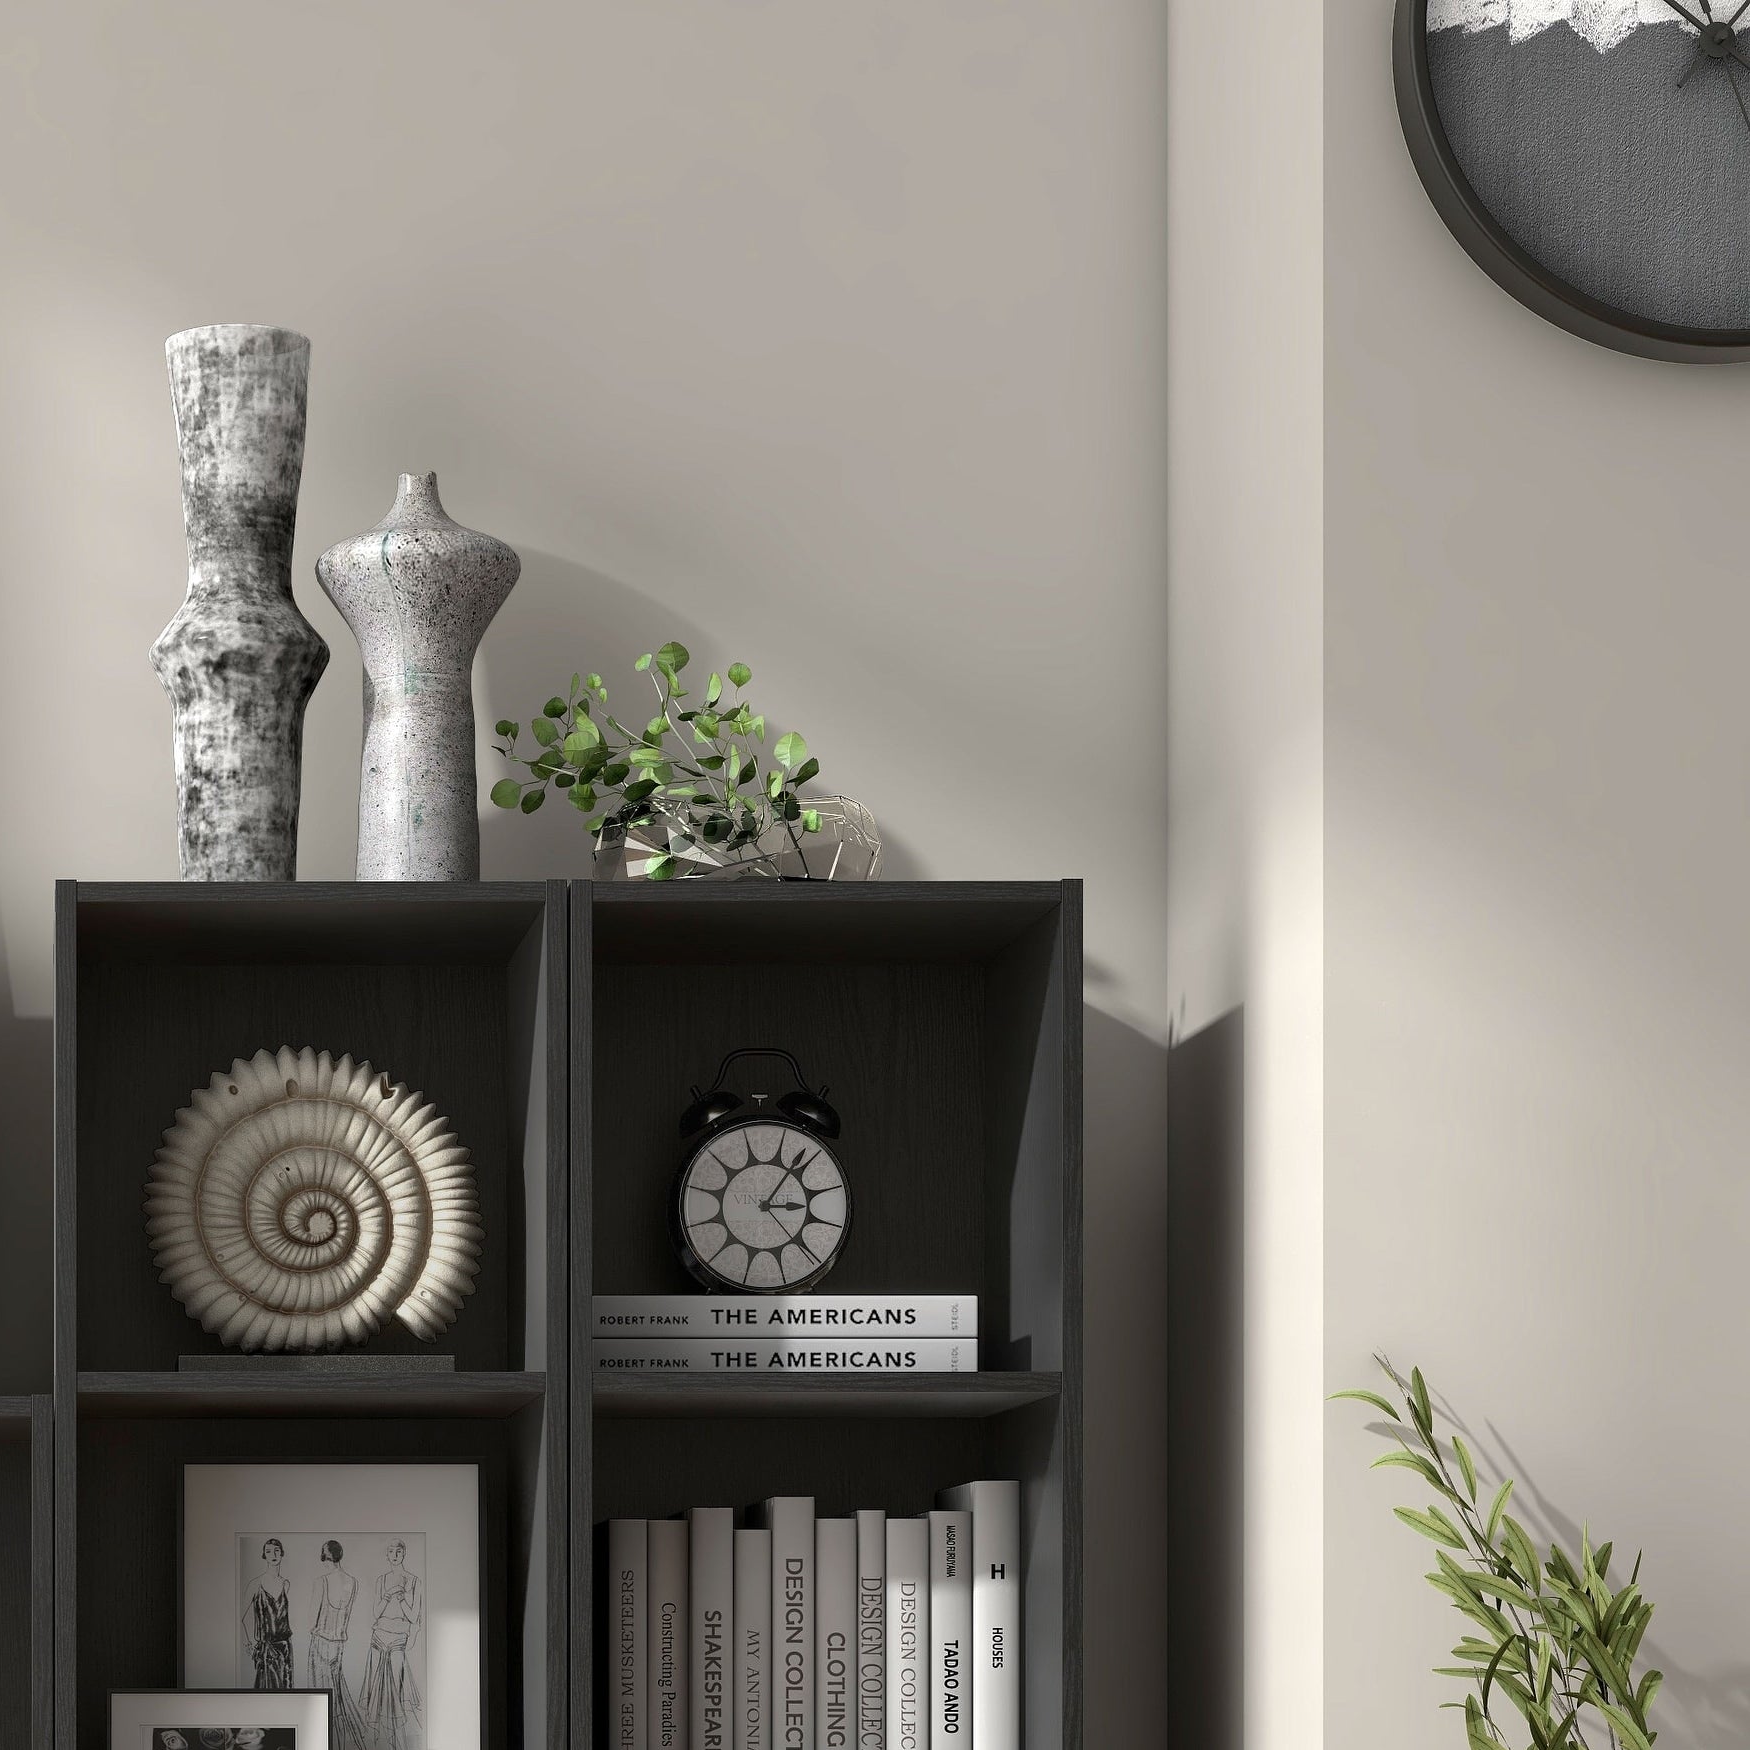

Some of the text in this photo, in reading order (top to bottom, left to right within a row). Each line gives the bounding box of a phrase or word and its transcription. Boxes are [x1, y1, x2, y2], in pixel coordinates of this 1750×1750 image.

[599, 1316, 689, 1325] ROBERT FRANK
[710, 1309, 917, 1324] THE AMERICANS
[599, 1359, 689, 1368] ROBERT FRANK
[710, 1352, 917, 1368] THE AMERICANS
[621, 1570, 634, 1696] MUSKETEERS
[785, 1558, 803, 1644] DESIGN
[860, 1576, 882, 1657] DESIGN
[900, 1582, 916, 1661] DESIGN
[658, 1602, 677, 1747] Constructing Paradies
[746, 1630, 760, 1660] MY
[992, 1627, 1003, 1669] HOUSES
[826, 1632, 846, 1747] CLOTHING
[944, 1640, 958, 1734] TADAO ANDO
